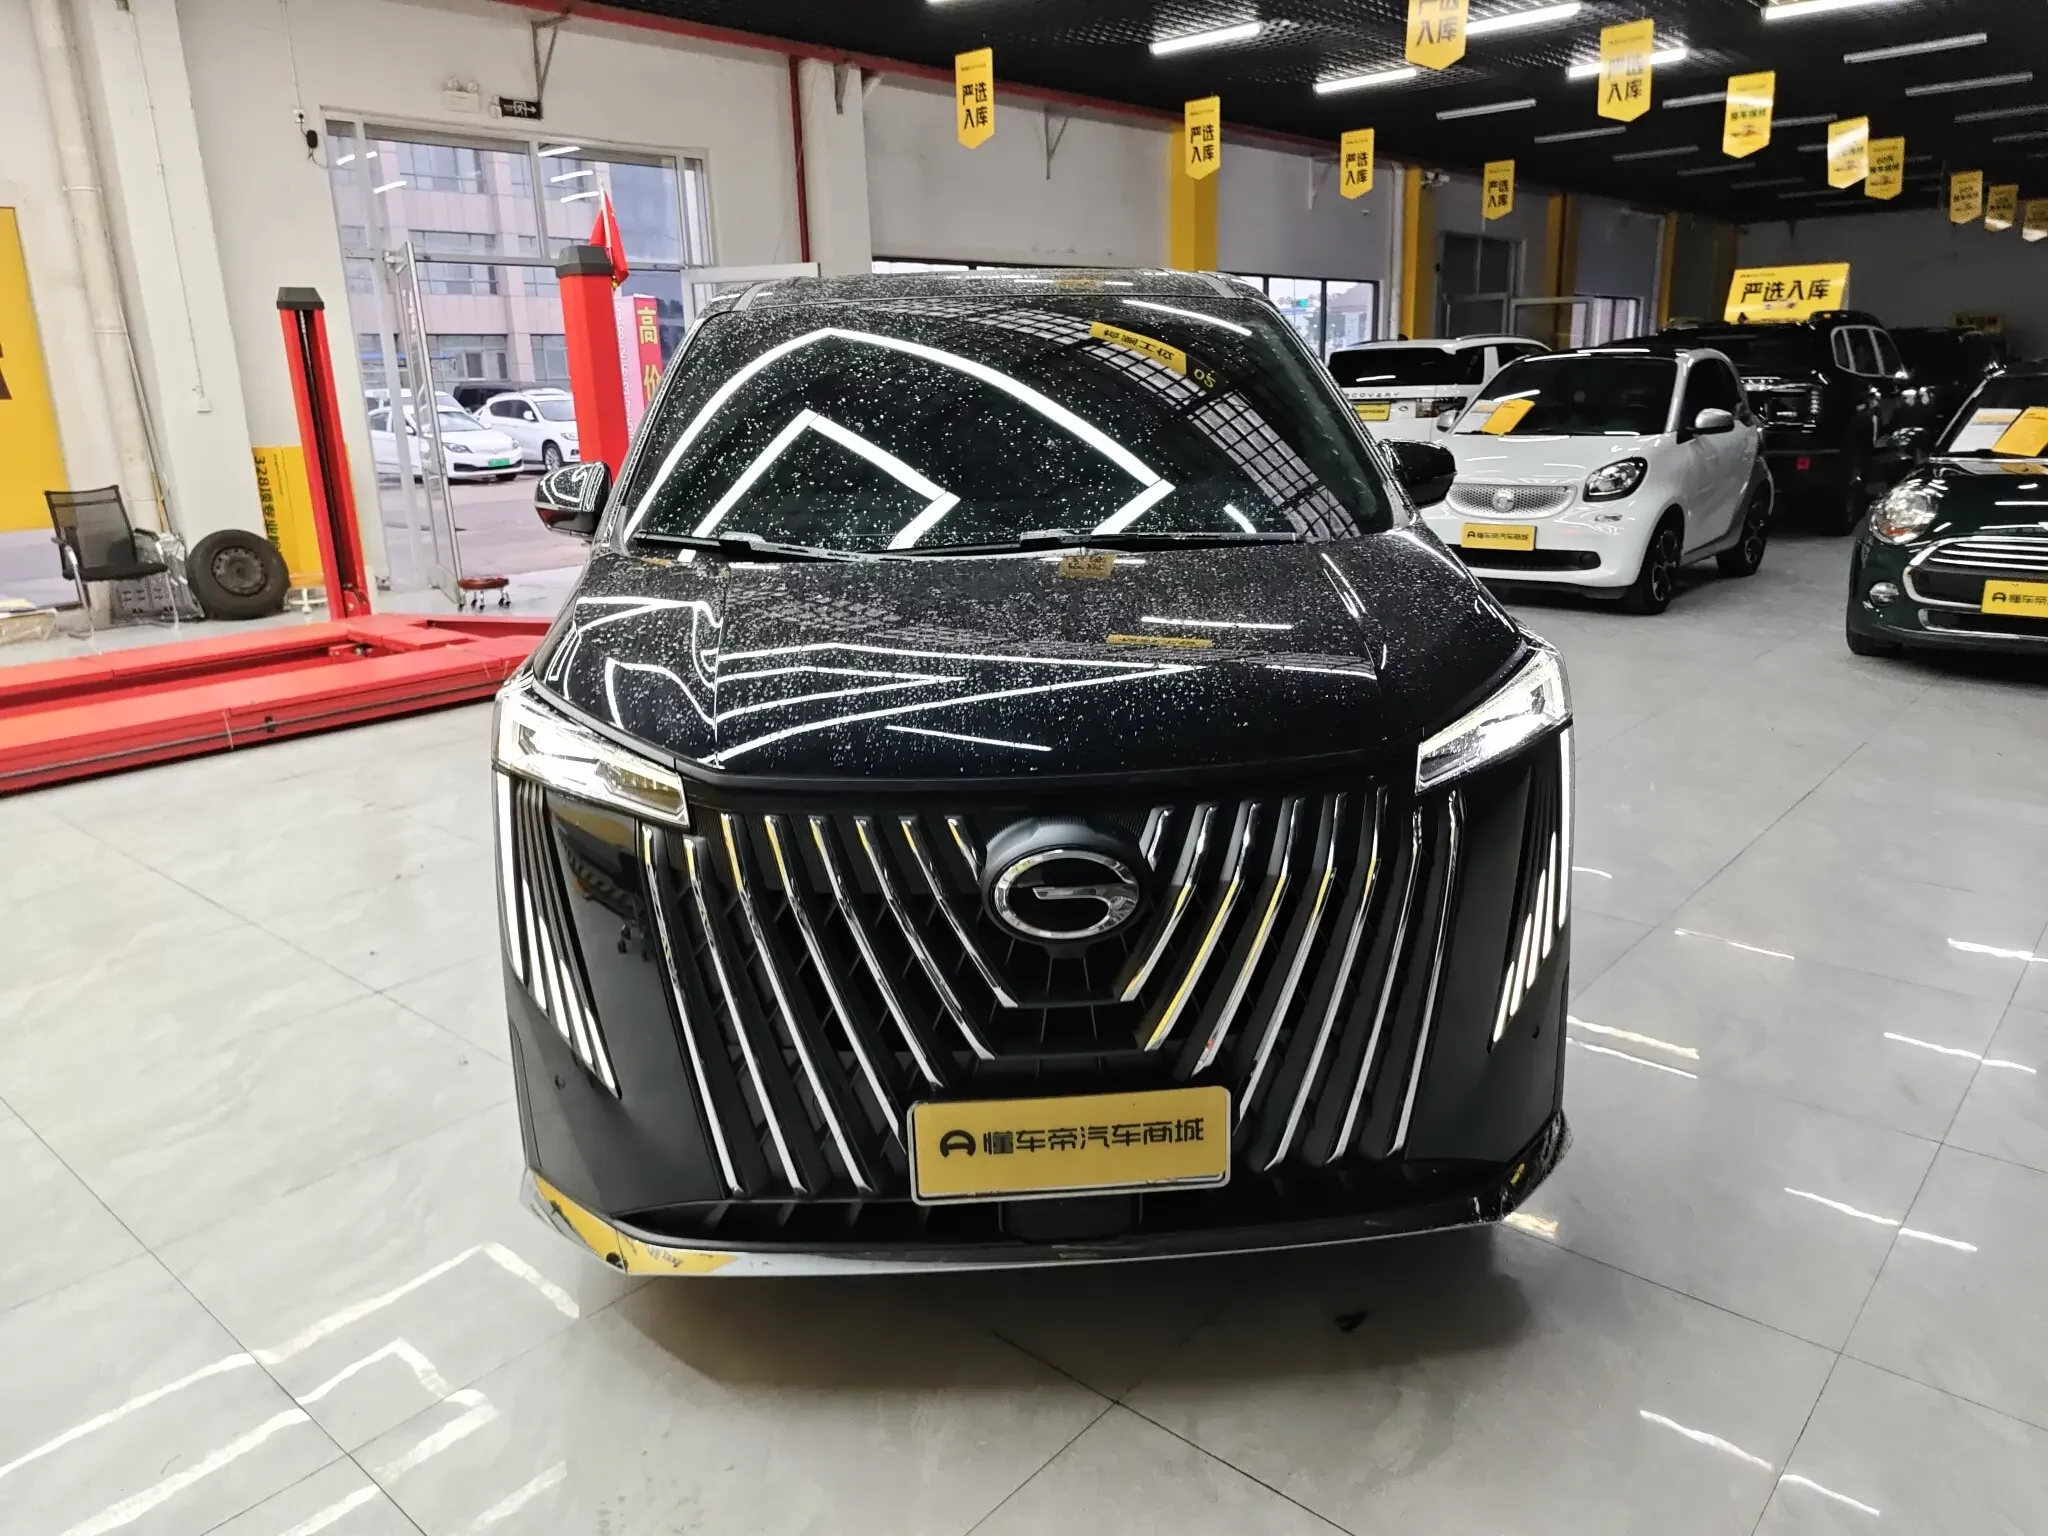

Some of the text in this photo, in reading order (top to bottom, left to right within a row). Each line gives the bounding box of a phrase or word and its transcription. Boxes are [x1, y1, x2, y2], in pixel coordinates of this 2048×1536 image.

[962, 82, 988, 105] 严选
[1607, 79, 1643, 104] 入库
[963, 106, 989, 130] 入库
[1190, 124, 1215, 144] 严选
[1190, 145, 1215, 164] 入库
[1345, 151, 1369, 169] 严选
[1345, 170, 1368, 186] 入库
[1741, 279, 1831, 304] 严选入库
[983, 1117, 1204, 1155] 懂车帝汽车商城
